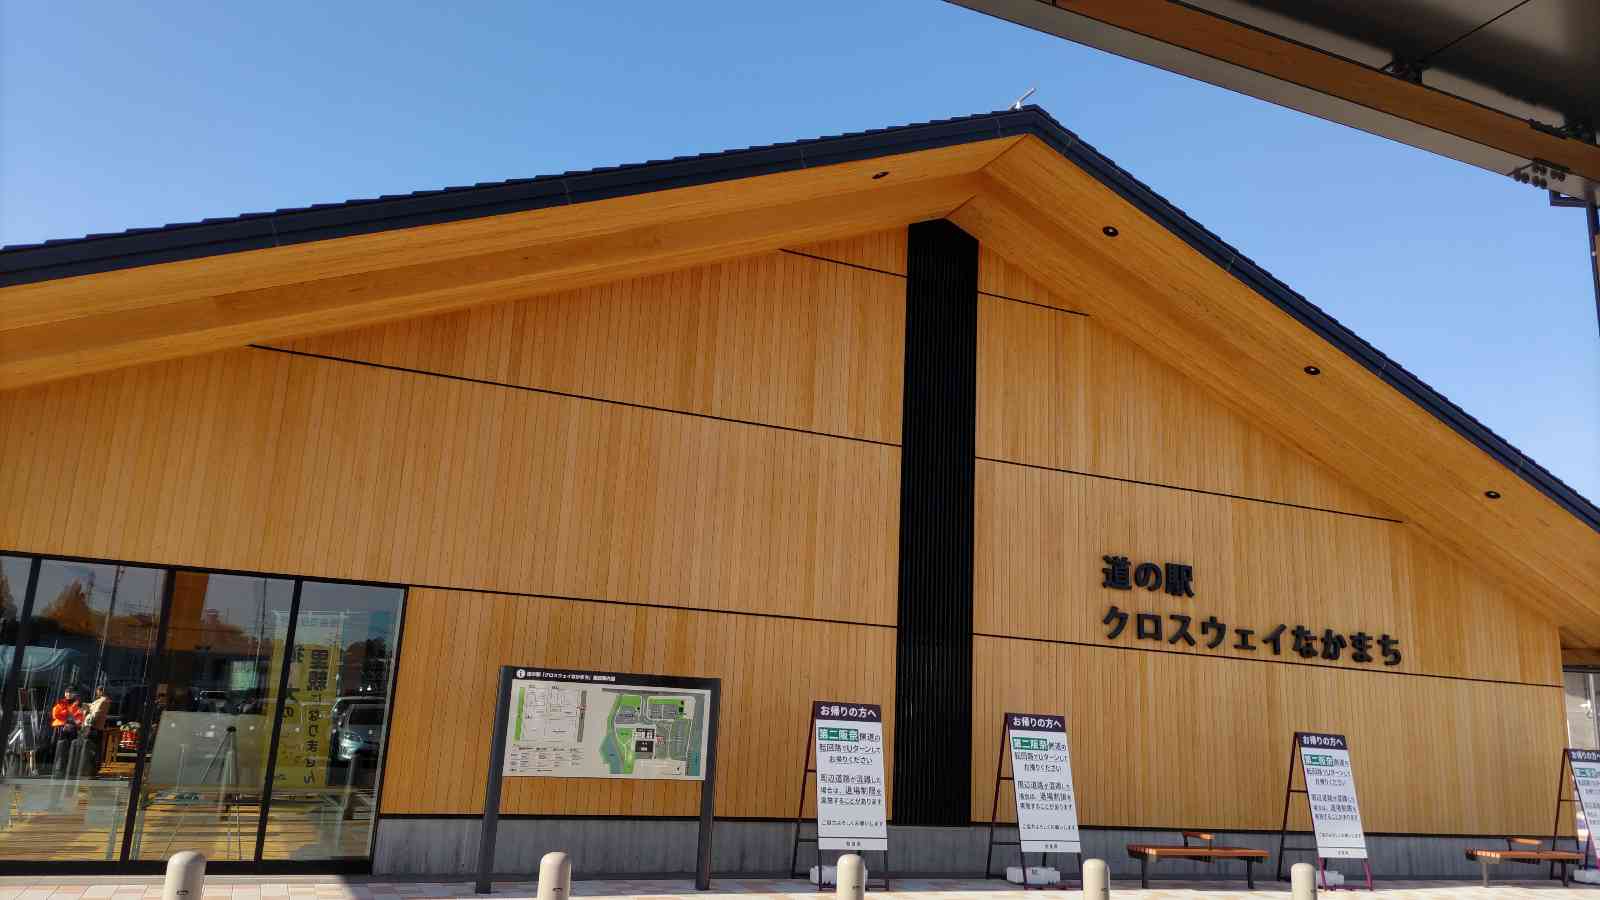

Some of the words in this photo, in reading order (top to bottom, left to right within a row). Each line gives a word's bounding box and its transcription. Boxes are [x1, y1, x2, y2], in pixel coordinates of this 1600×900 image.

[1101, 555, 1195, 597] 道の駅
[1101, 605, 1403, 667] クロスウェイなかまち
[820, 704, 877, 719] お帰りの方へ
[1012, 716, 1062, 729] お帰りの方へ
[1302, 735, 1344, 747] お帰りの方へ
